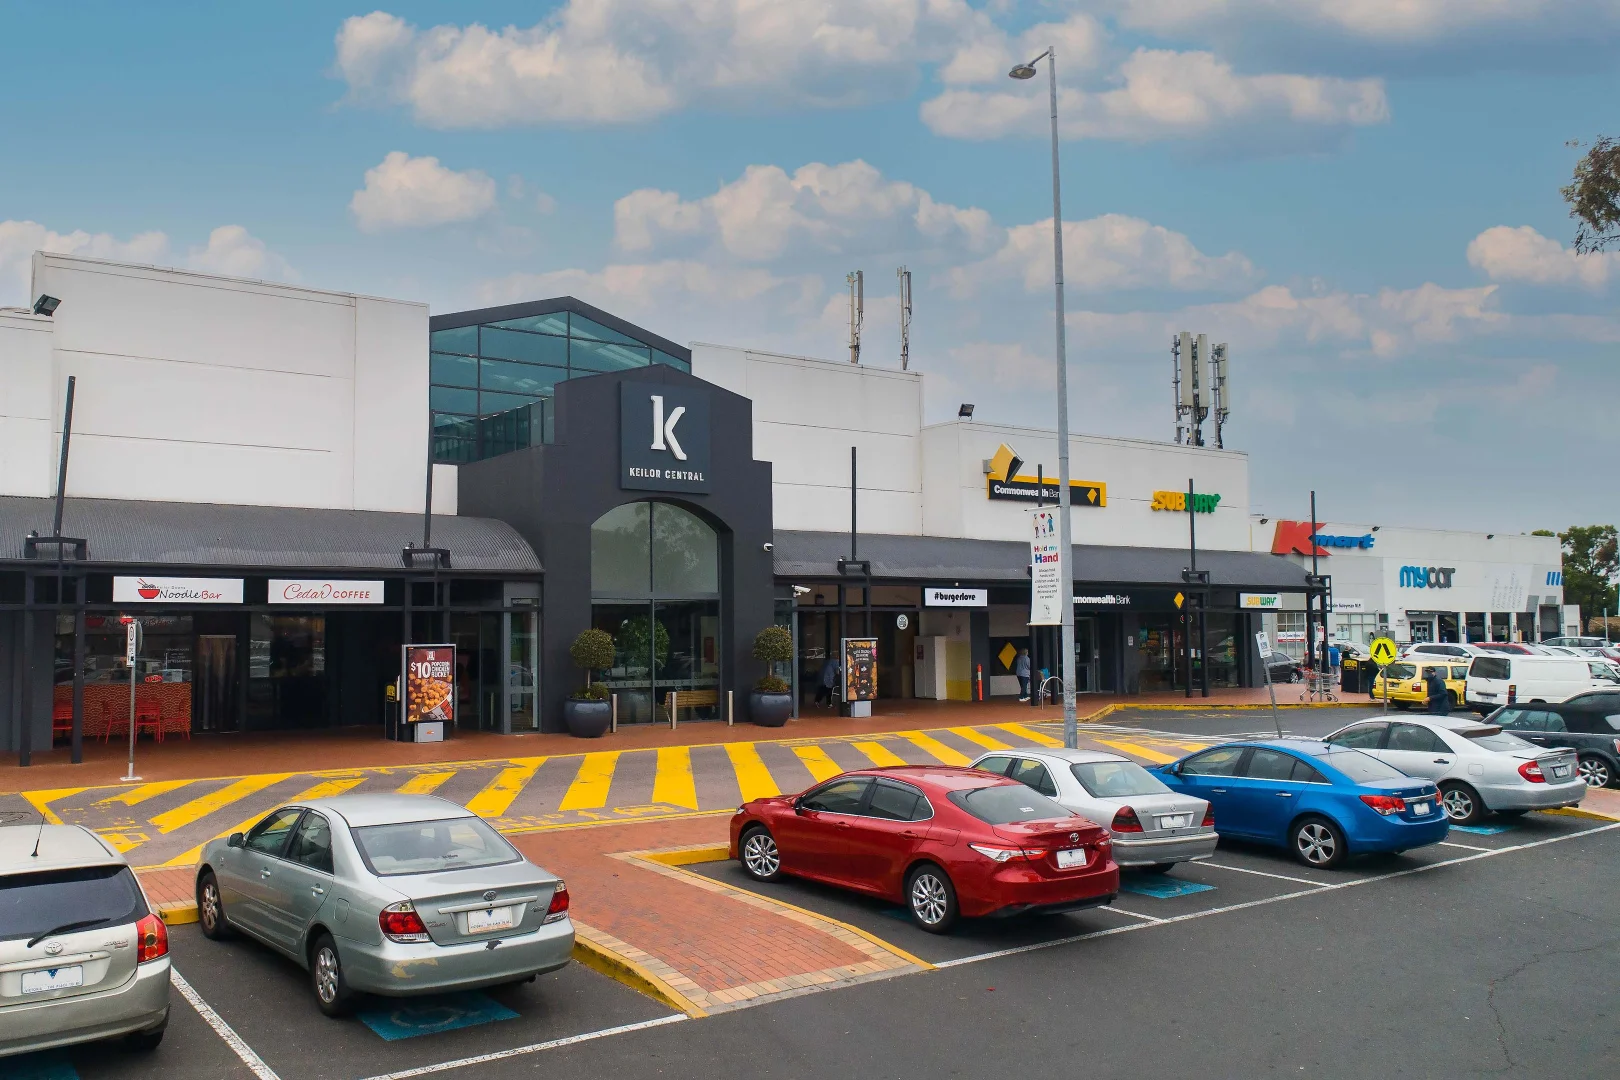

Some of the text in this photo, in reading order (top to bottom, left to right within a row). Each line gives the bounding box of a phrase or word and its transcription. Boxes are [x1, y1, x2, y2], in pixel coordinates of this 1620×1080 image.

[651, 395, 687, 460] K
[629, 467, 704, 481] KEILOR CENTRAL
[994, 485, 1060, 498] Commonweath Ban
[1151, 491, 1221, 513] SUBWAY
[1034, 545, 1048, 553] Hold
[1035, 552, 1059, 563] Hand
[201, 590, 222, 599] Bar
[283, 583, 370, 600] Cedar COFFEE
[934, 592, 976, 602] #burgerlove
[1073, 594, 1131, 605] mmonwealth Bank
[1246, 596, 1277, 606] SUBWAY
[411, 661, 432, 679] $10
